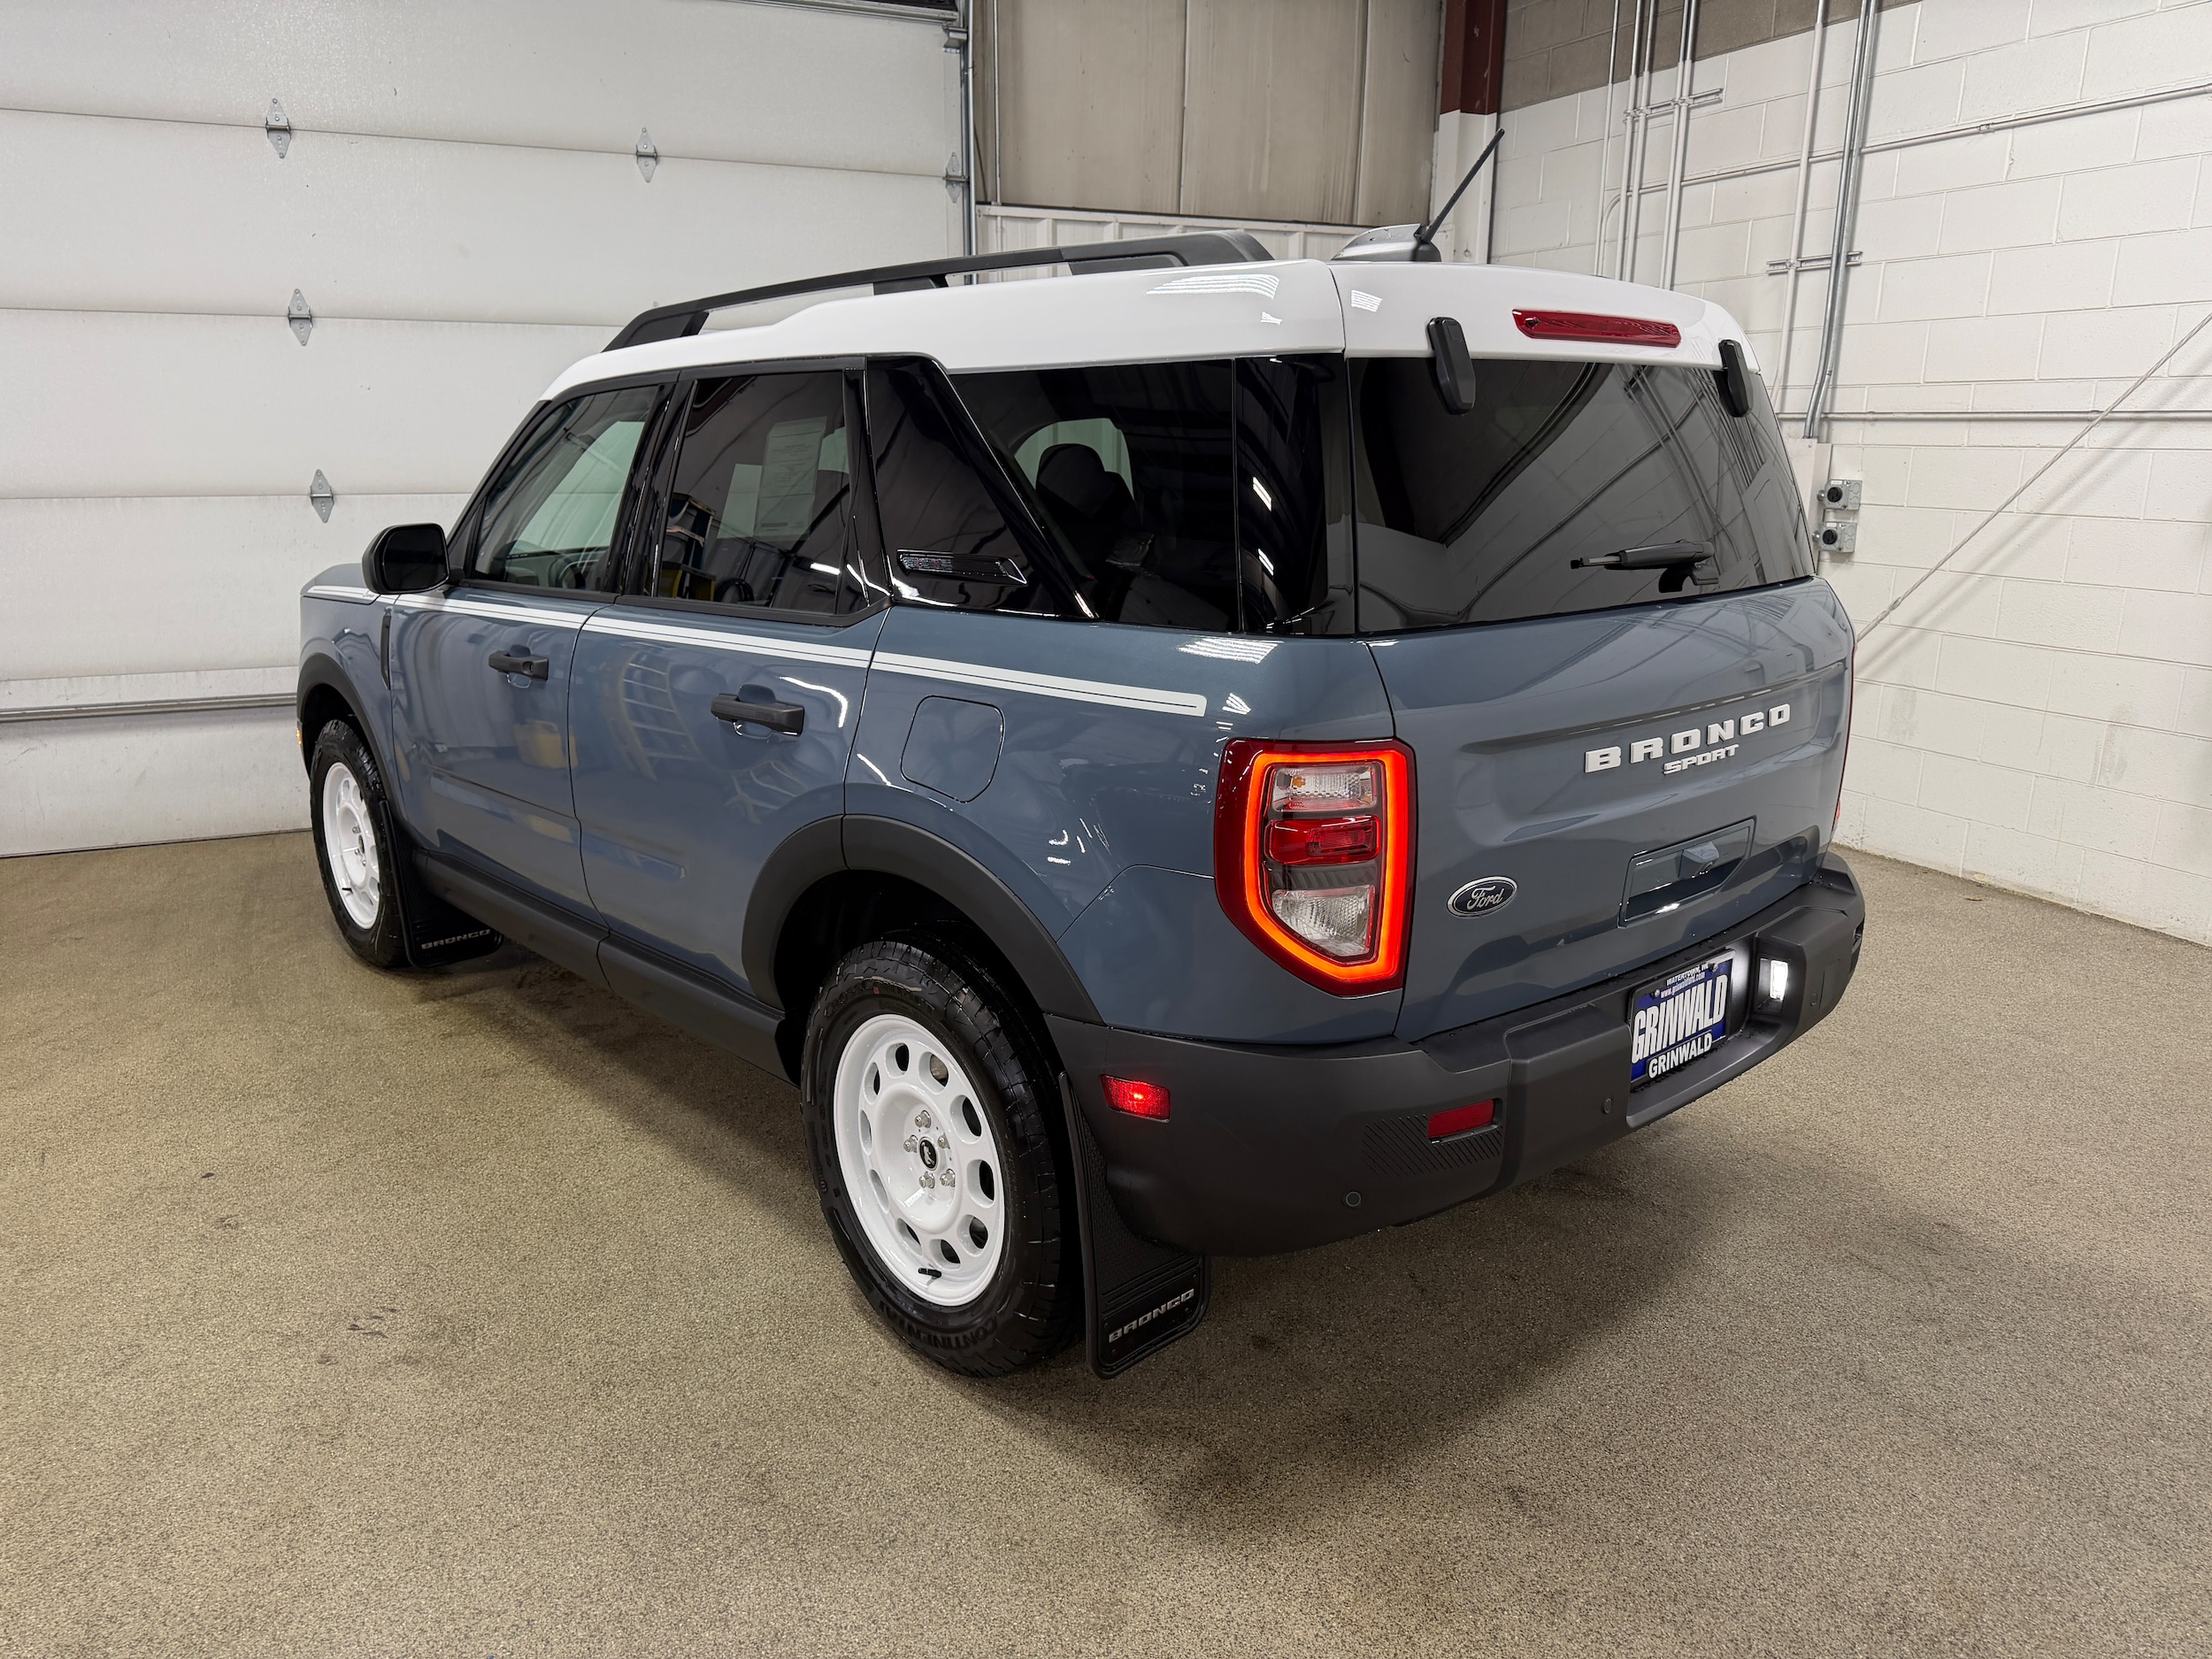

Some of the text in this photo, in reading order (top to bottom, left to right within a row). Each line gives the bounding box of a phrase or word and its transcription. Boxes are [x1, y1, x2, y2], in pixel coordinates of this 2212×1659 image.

[1585, 703, 1790, 772] BRONCO
[1663, 744, 1740, 774] SPORT
[1466, 886, 1504, 910] Ford
[421, 929, 490, 949] BRONCO
[1632, 974, 1728, 1064] GRINWALD
[1648, 1033, 1713, 1079] GRINWALD
[1109, 1288, 1194, 1343] BRONCO
